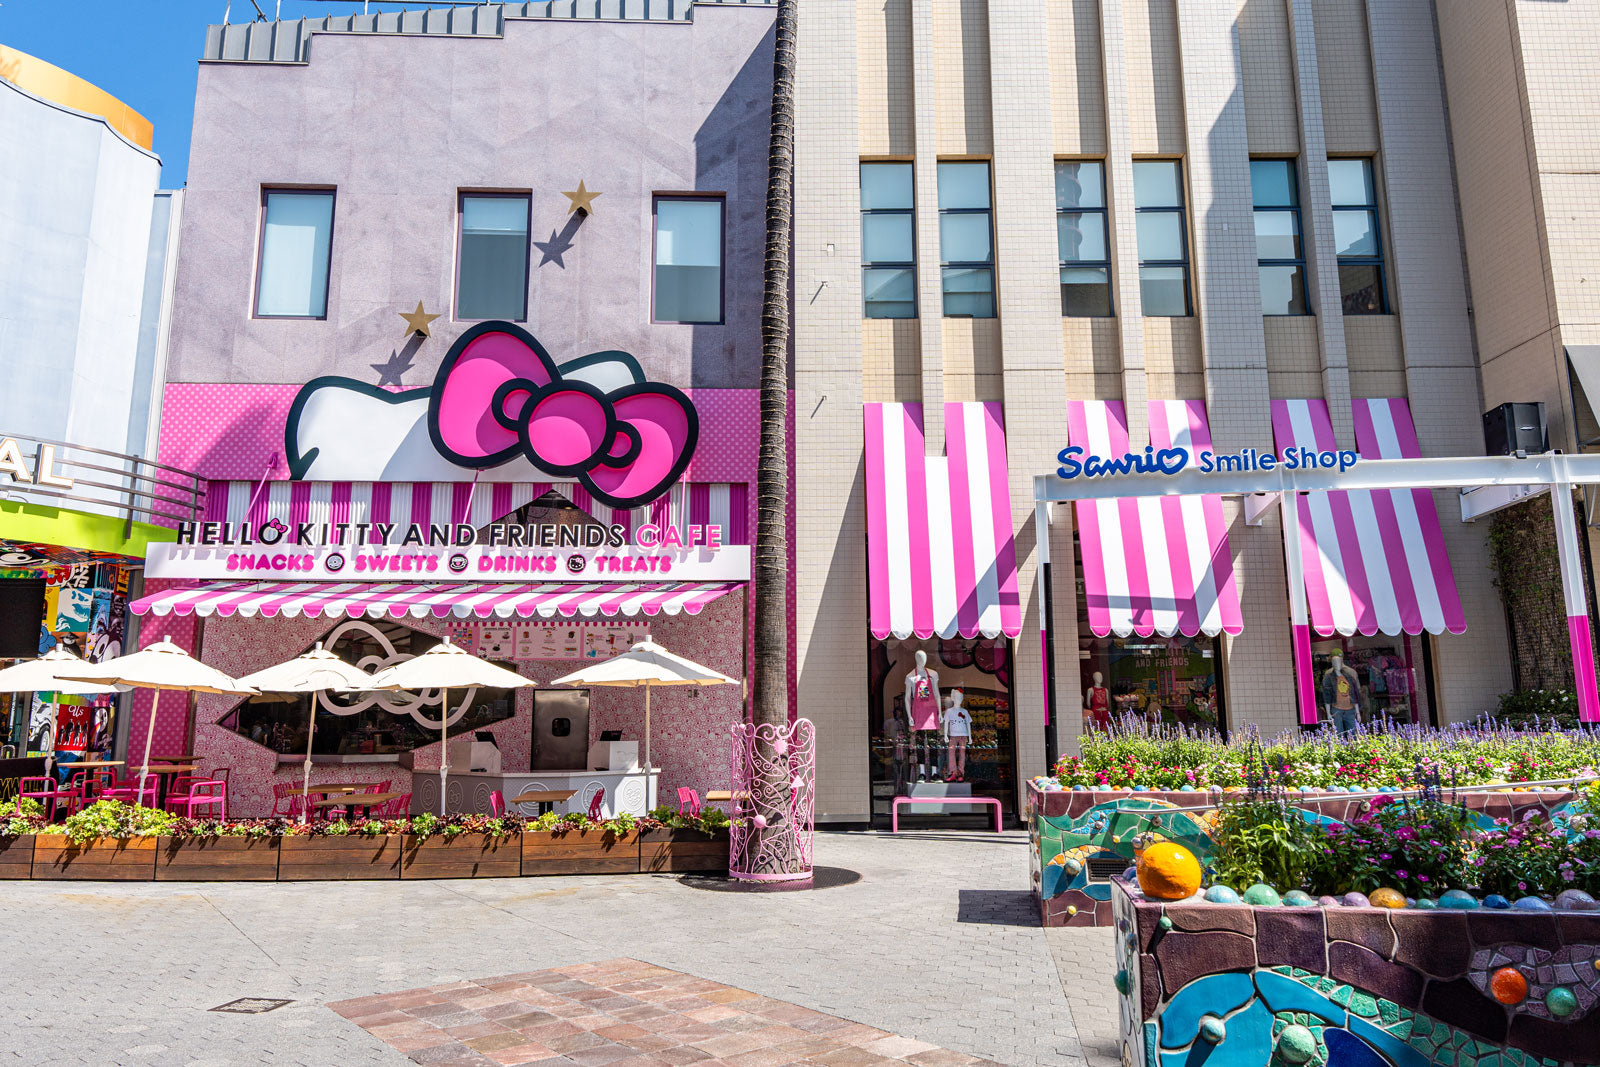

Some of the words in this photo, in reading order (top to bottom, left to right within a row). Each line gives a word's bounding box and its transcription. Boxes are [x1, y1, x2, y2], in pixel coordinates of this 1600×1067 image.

[1057, 446, 1188, 479] Sanrio
[1200, 449, 1276, 473] Smile
[1284, 447, 1357, 472] Shop
[177, 518, 288, 546] HELLO
[296, 523, 396, 547] KITTY
[402, 523, 477, 548] AND
[489, 524, 625, 548] FRIENDS
[636, 525, 722, 548] CAFE
[226, 554, 315, 571] SNACKS
[355, 555, 439, 572] SWEETS
[478, 556, 557, 572] DRINKS
[595, 555, 672, 573] TREATS
[1135, 659, 1151, 668] AND
[1155, 657, 1189, 667] FRIENDS
